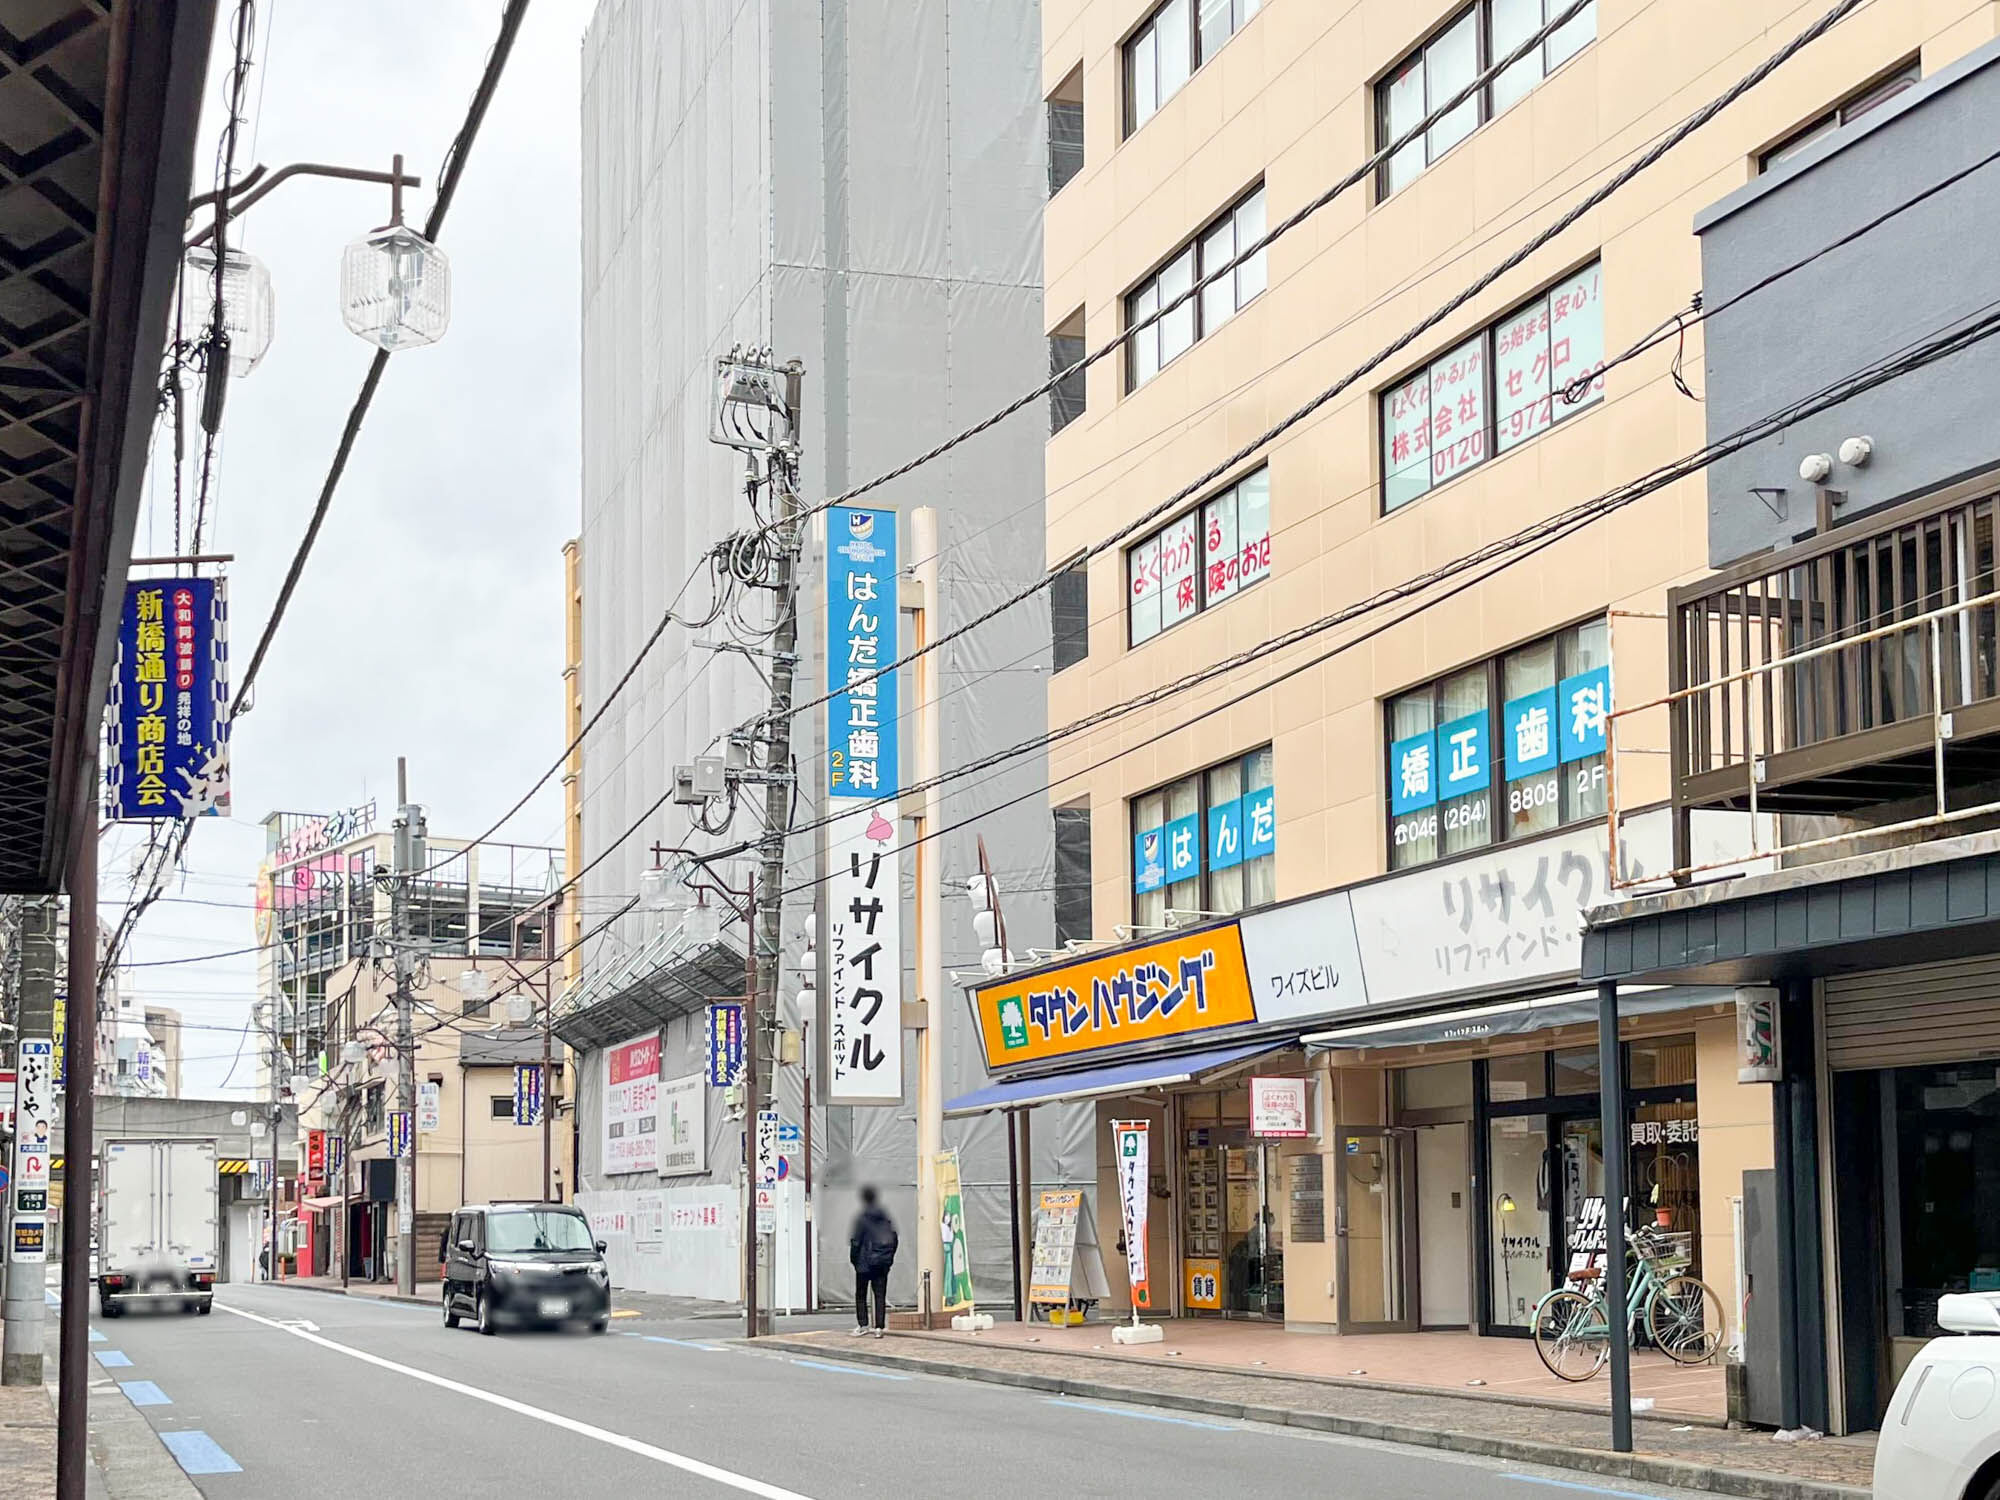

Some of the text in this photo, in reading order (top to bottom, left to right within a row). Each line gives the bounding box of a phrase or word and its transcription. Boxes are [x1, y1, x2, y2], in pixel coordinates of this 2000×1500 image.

[136, 589, 167, 805] 新橋通り商店会
[847, 571, 879, 790] はんだ矯正歯科
[1401, 682, 1606, 799] 矯正歯科
[1576, 764, 1605, 794] 2F
[1172, 797, 1273, 871] はんだ
[849, 852, 886, 1071] リサイクル
[1271, 964, 1340, 998] ワイズビル
